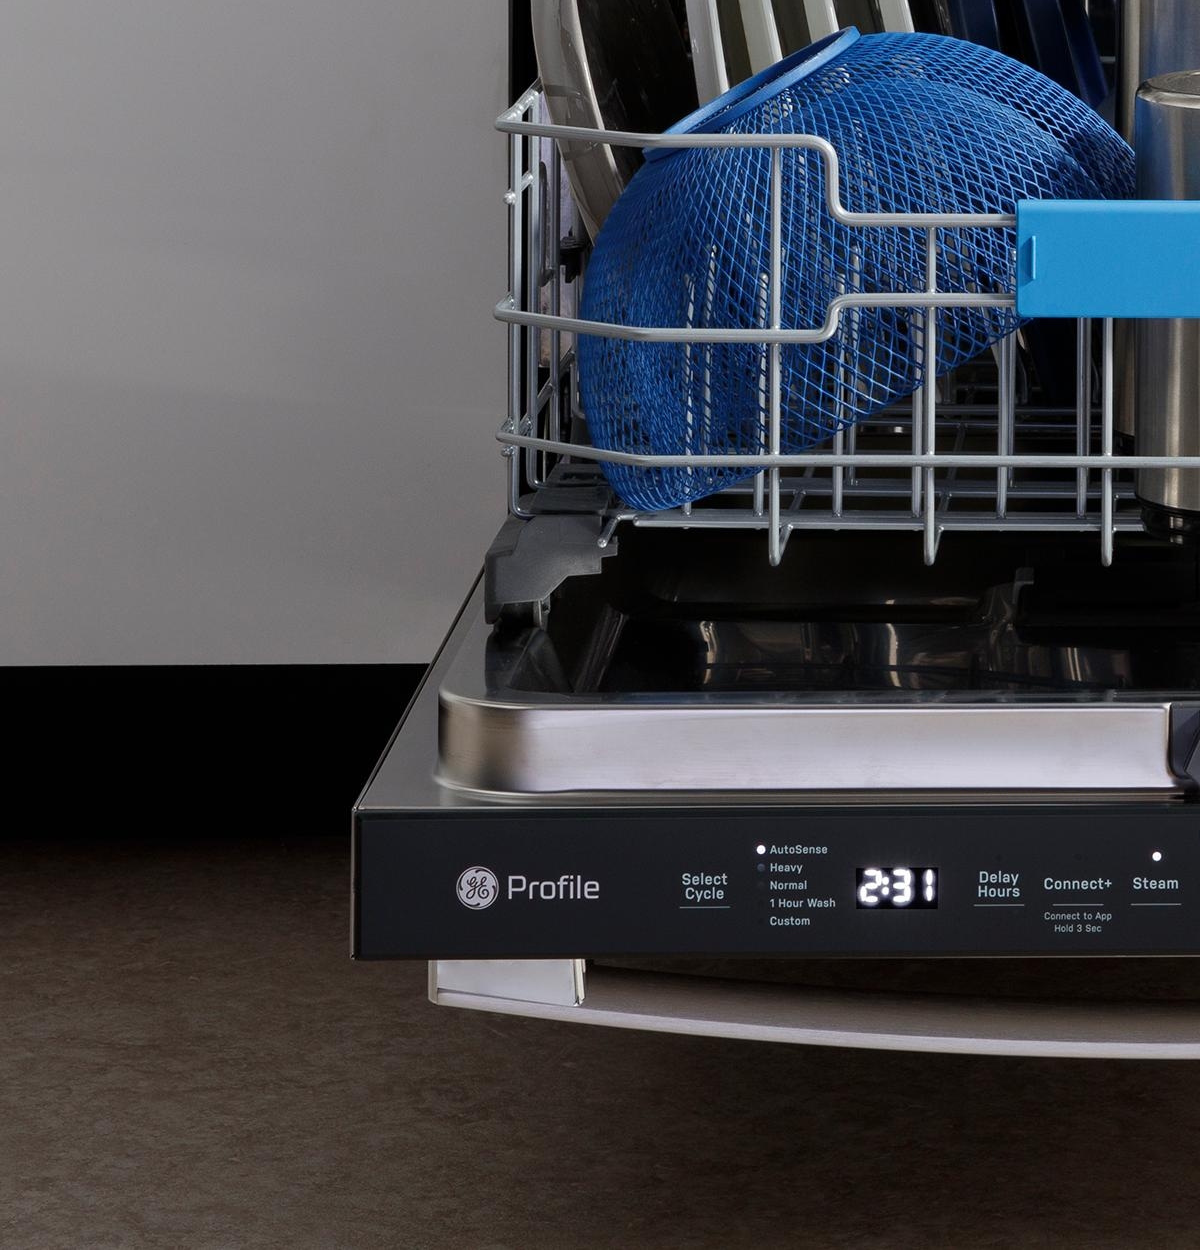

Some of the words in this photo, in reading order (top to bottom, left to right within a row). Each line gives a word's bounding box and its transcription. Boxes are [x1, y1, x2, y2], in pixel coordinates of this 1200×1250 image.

[769, 844, 828, 855] AutoSense
[770, 862, 803, 875] Heavy
[681, 872, 728, 886] Select
[979, 870, 1019, 886] Delay
[1043, 877, 1113, 890] Connect+
[1132, 876, 1179, 890] Steam
[507, 874, 600, 900] Profile
[769, 879, 808, 891] Normal
[860, 868, 933, 904] 2:31
[977, 884, 1021, 898] Hours
[685, 886, 725, 903] Cycle
[769, 898, 775, 908] 1
[778, 898, 804, 908] Hour
[806, 897, 836, 908] Wash
[769, 915, 811, 926] Custom
[1043, 911, 1081, 921] Connect
[1083, 912, 1093, 921] to
[1097, 911, 1113, 923] App
[1054, 923, 1074, 933] Hold
[1076, 923, 1083, 933] 3
[1085, 923, 1102, 933] Sec
